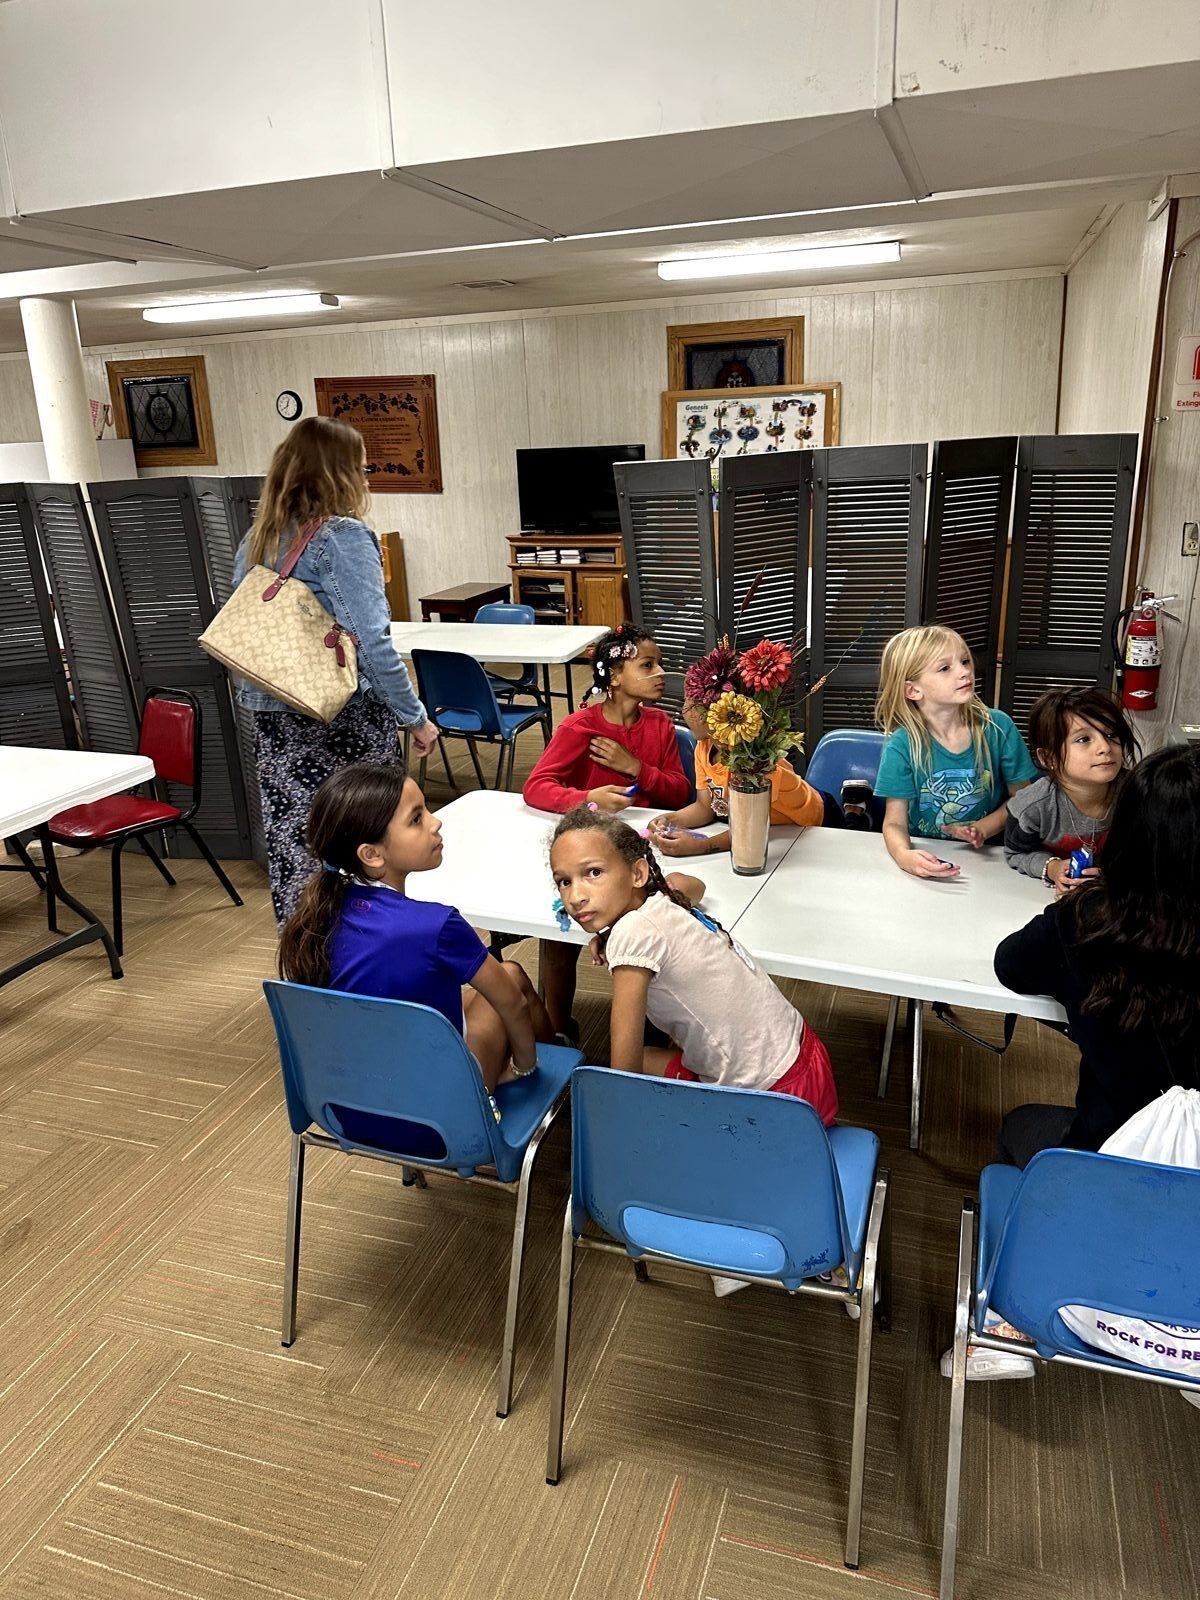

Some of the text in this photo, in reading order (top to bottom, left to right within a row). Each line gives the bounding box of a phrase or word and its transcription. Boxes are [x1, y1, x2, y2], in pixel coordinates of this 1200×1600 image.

[685, 403, 709, 411] Genesis
[1096, 1320, 1141, 1346] ROCK
[1144, 1340, 1177, 1358] FOR
